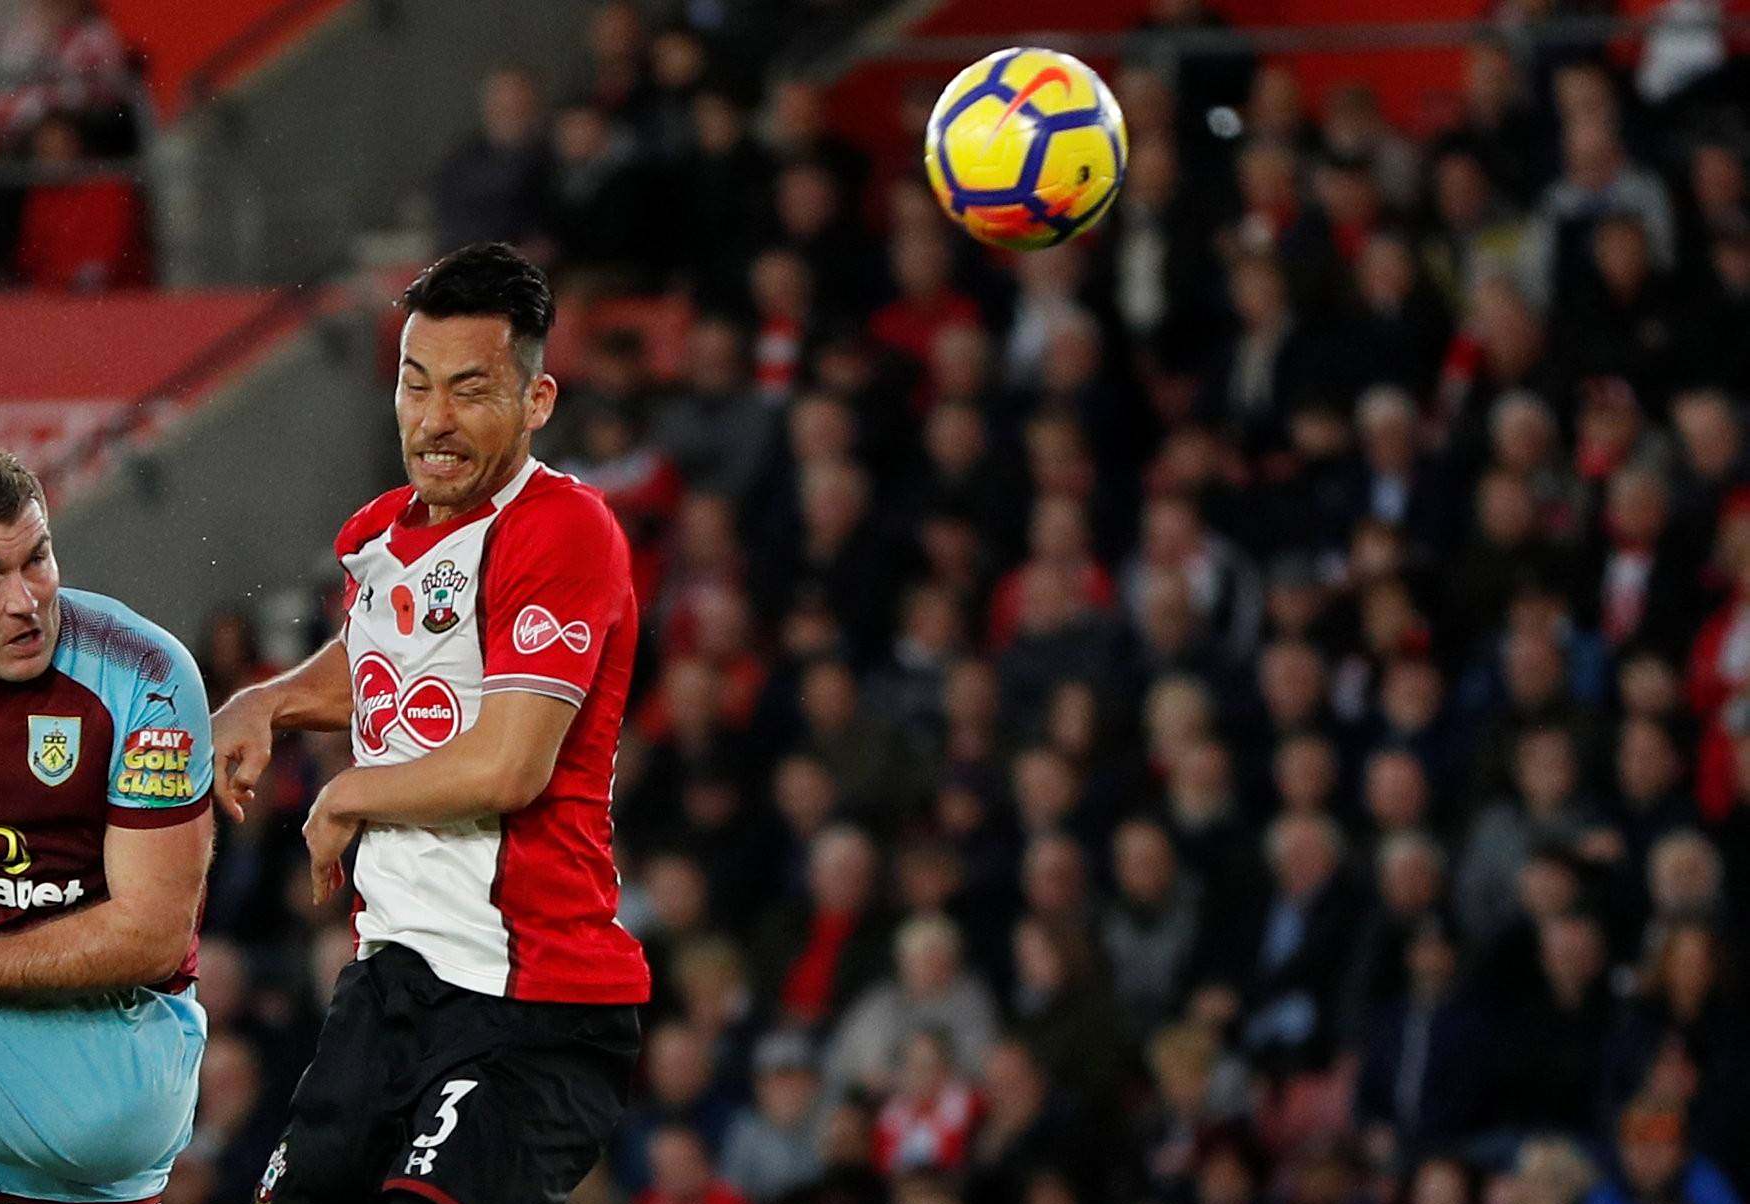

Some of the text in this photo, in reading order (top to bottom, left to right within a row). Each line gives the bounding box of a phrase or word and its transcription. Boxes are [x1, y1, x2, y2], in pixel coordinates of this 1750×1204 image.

[407, 704, 452, 719] media
[138, 730, 185, 748] PLAY
[123, 747, 190, 771] GOLF
[116, 769, 194, 798] CLASH
[412, 1079, 478, 1148] 3
